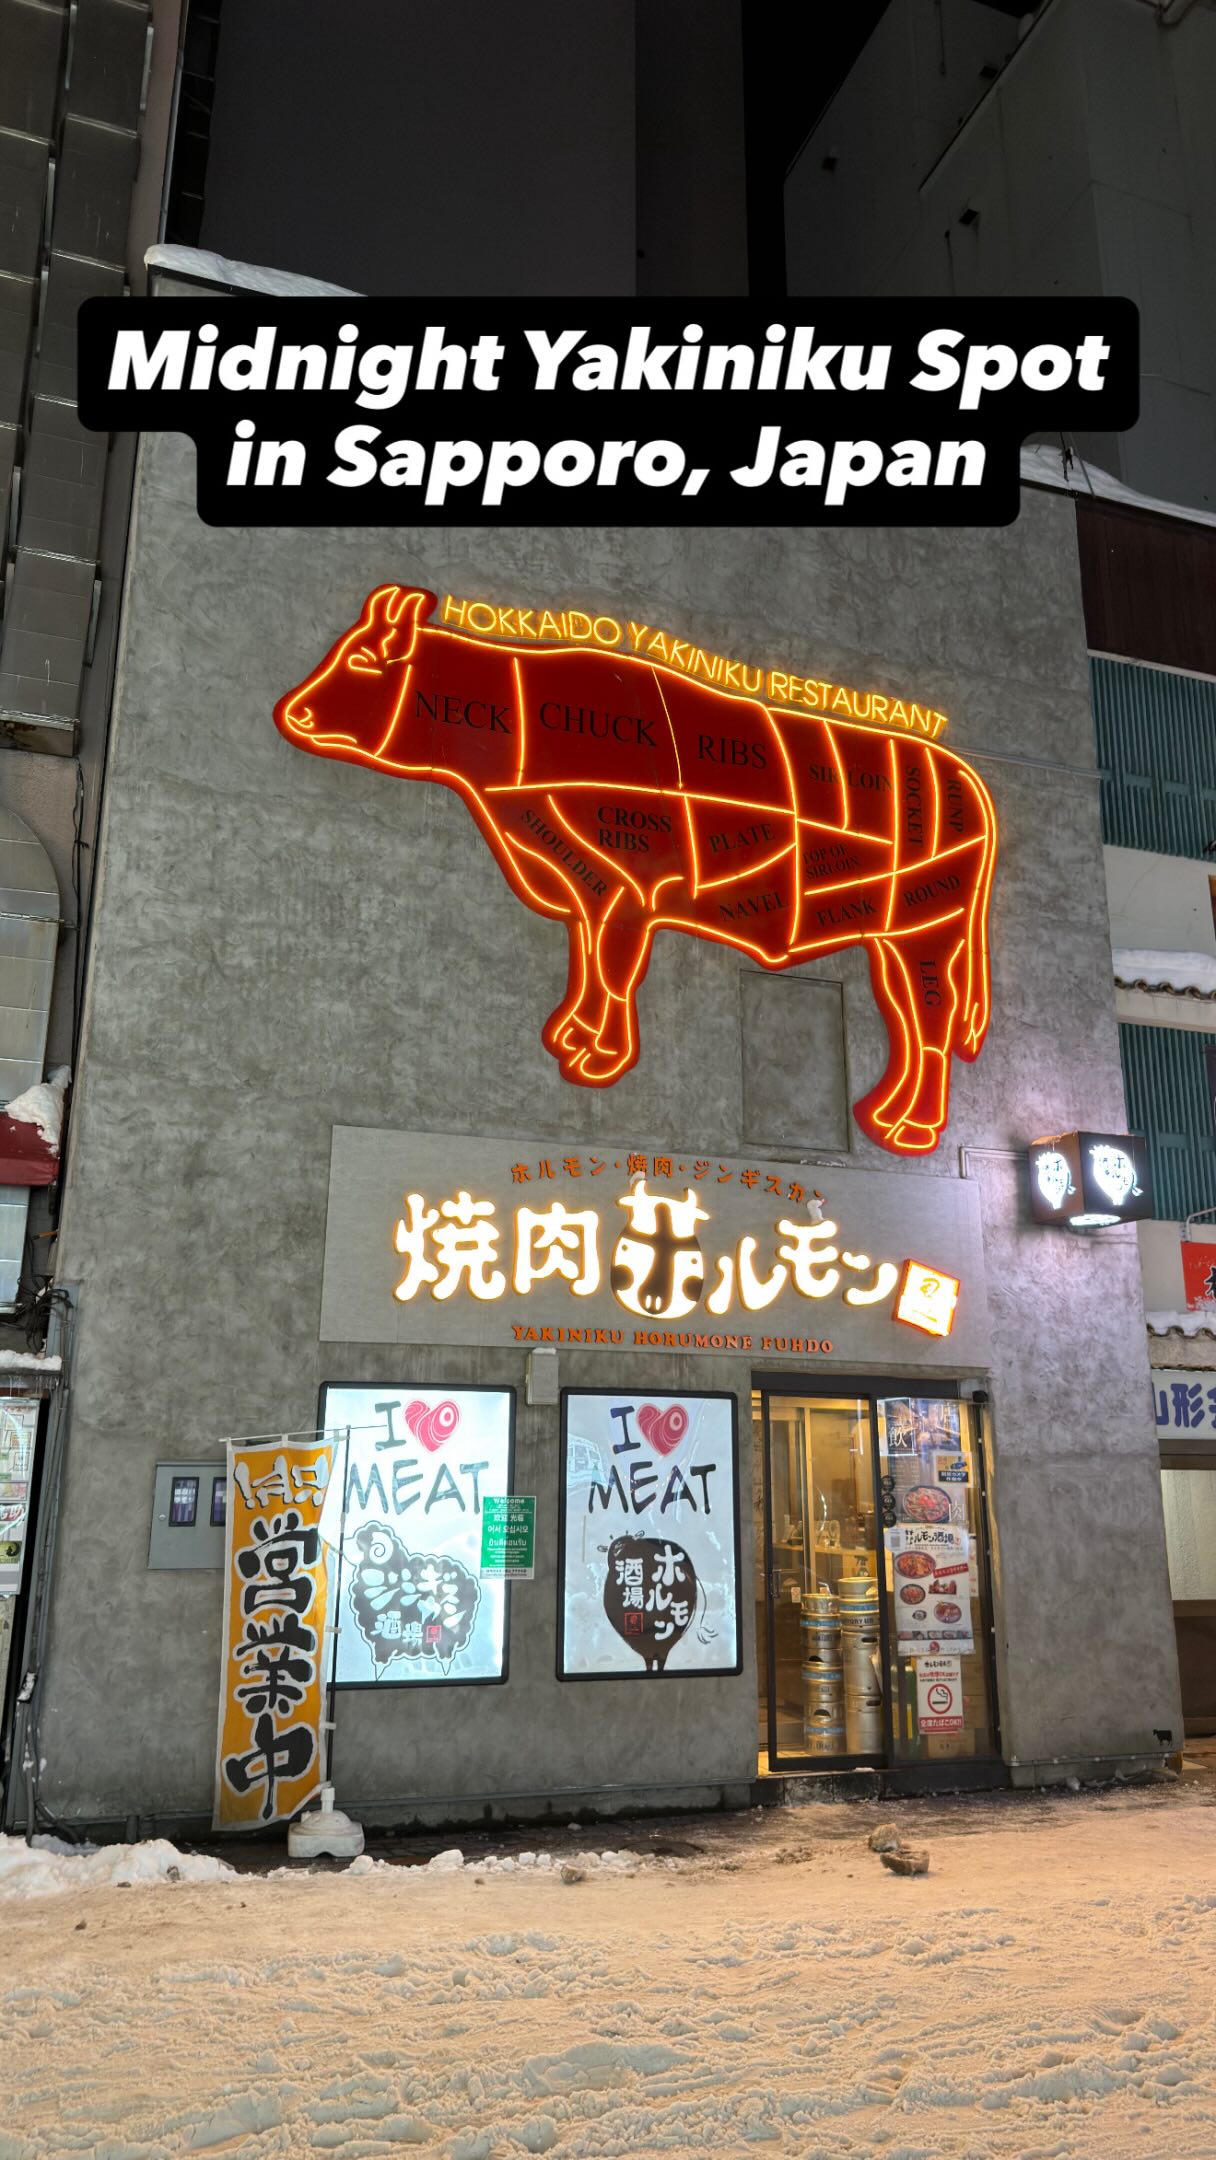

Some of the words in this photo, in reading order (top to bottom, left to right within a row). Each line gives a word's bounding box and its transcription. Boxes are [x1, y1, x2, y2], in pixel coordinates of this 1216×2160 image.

[444, 595, 620, 645] HOKKAIDO
[630, 622, 761, 692] YAKINIKU
[768, 671, 948, 738] RESTAURANT
[415, 690, 512, 734] NECK
[539, 701, 657, 747] CHUCK
[697, 734, 768, 769] RIBS
[597, 805, 672, 832] CROSS
[905, 767, 924, 848] SOCKET
[521, 809, 607, 896] SHOULDER
[598, 829, 650, 852] RIBS
[710, 823, 775, 852] PLATE
[720, 891, 786, 922] NAVEL
[903, 874, 960, 907] ROUND
[816, 900, 878, 926] FLANK
[511, 1325, 625, 1344] YAKINIKU
[633, 1330, 752, 1349] HORUMONE
[762, 1336, 833, 1353] FUHDO
[374, 1401, 406, 1451] I
[610, 1405, 641, 1455] I
[344, 1459, 489, 1515] MEAT
[493, 1497, 525, 1505] Welcome
[588, 1461, 716, 1515] MEAT
[615, 1558, 644, 1610] 酒場
[645, 1545, 689, 1641] ホルモン
[370, 1611, 423, 1647] 酒場
